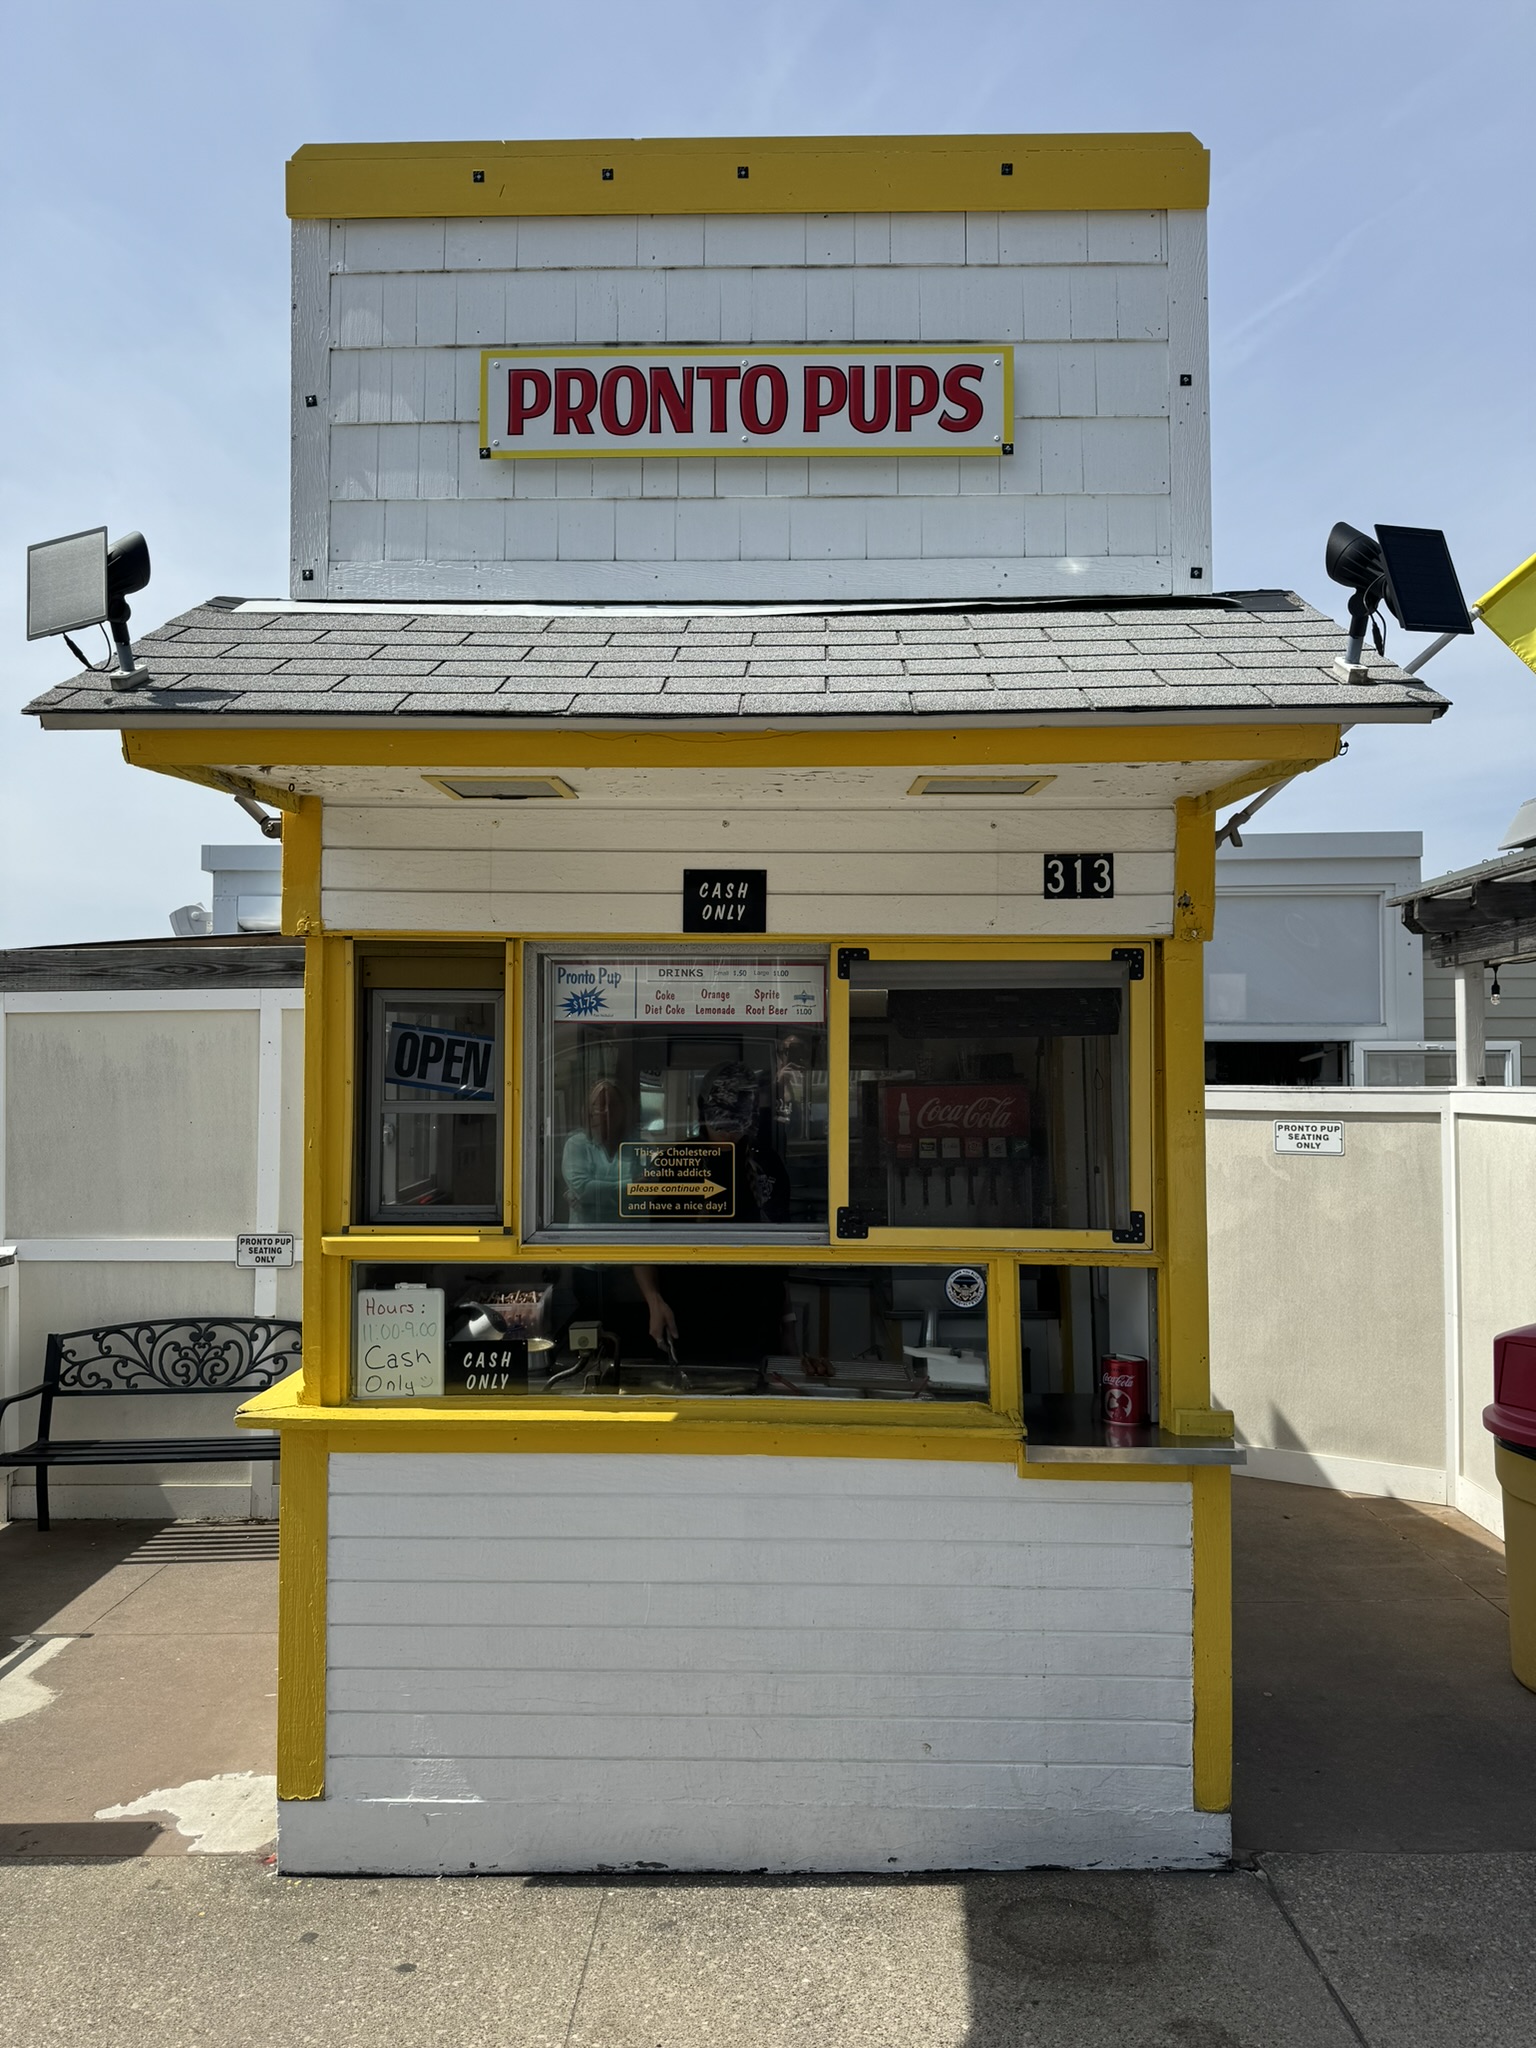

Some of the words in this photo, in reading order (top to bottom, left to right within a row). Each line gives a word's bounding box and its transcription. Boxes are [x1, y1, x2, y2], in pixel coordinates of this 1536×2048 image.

[507, 365, 788, 436] PRONTO
[803, 364, 985, 434] PUPS
[1047, 858, 1111, 893] 313
[699, 882, 748, 899] CASH
[702, 904, 746, 921] ONLY
[557, 967, 596, 985] Pronto
[598, 967, 622, 989] Pup
[658, 968, 704, 978] DRINKS
[655, 990, 675, 1001] Coke
[701, 988, 731, 1002] Orange
[754, 988, 781, 1002] Sprite
[573, 995, 597, 1009] $1.75
[645, 1004, 662, 1015] Diet
[665, 1004, 686, 1015] Coke
[695, 1004, 736, 1015] Lemonade
[745, 1004, 766, 1015] Root
[768, 1004, 788, 1015] Beer
[394, 1031, 493, 1089] OPEN
[1277, 1124, 1318, 1133] PRONTO
[1320, 1125, 1341, 1133] PUP
[1288, 1133, 1330, 1141] SEATING
[634, 1147, 654, 1157] This
[656, 1147, 664, 1157] is
[666, 1147, 721, 1157] Cholesterol
[654, 1158, 701, 1167] COUNTRY
[643, 1168, 675, 1178] health
[676, 1168, 712, 1178] addicts
[630, 1184, 659, 1194] please
[661, 1184, 701, 1193] continue
[702, 1185, 715, 1193] on
[628, 1201, 647, 1211] and
[649, 1201, 673, 1211] have
[674, 1203, 681, 1211] a
[683, 1201, 703, 1211] nice
[705, 1201, 727, 1213] day!
[240, 1238, 273, 1246] PRONTO
[275, 1238, 291, 1246] PUP
[365, 1345, 431, 1370] Cash
[463, 1351, 511, 1368] CASH
[365, 1375, 415, 1397] Only
[466, 1373, 509, 1390] ONLY
